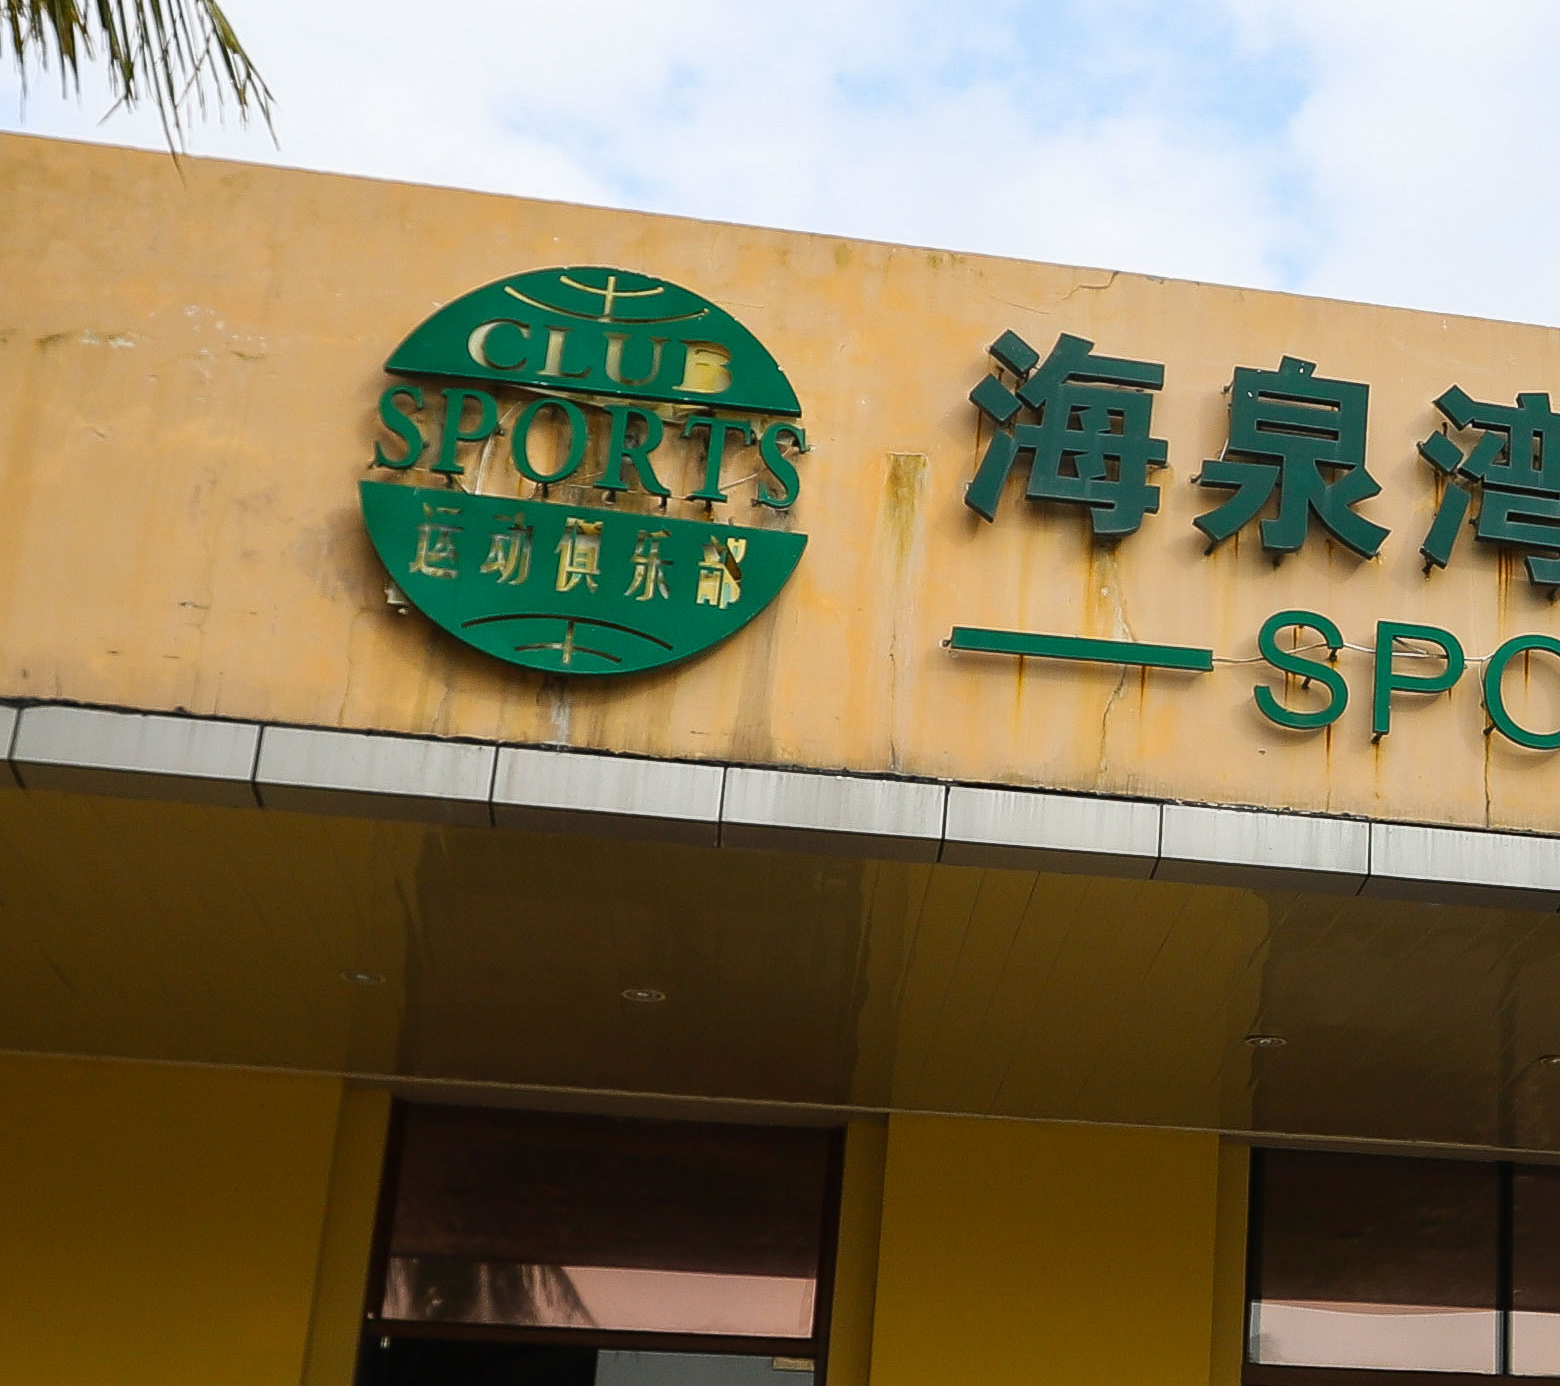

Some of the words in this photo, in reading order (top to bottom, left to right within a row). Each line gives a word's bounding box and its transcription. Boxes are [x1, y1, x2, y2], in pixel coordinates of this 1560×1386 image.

[466, 318, 735, 394] CLUB
[374, 385, 809, 509] SPORTS
[408, 503, 747, 610] 运动俱乐部
